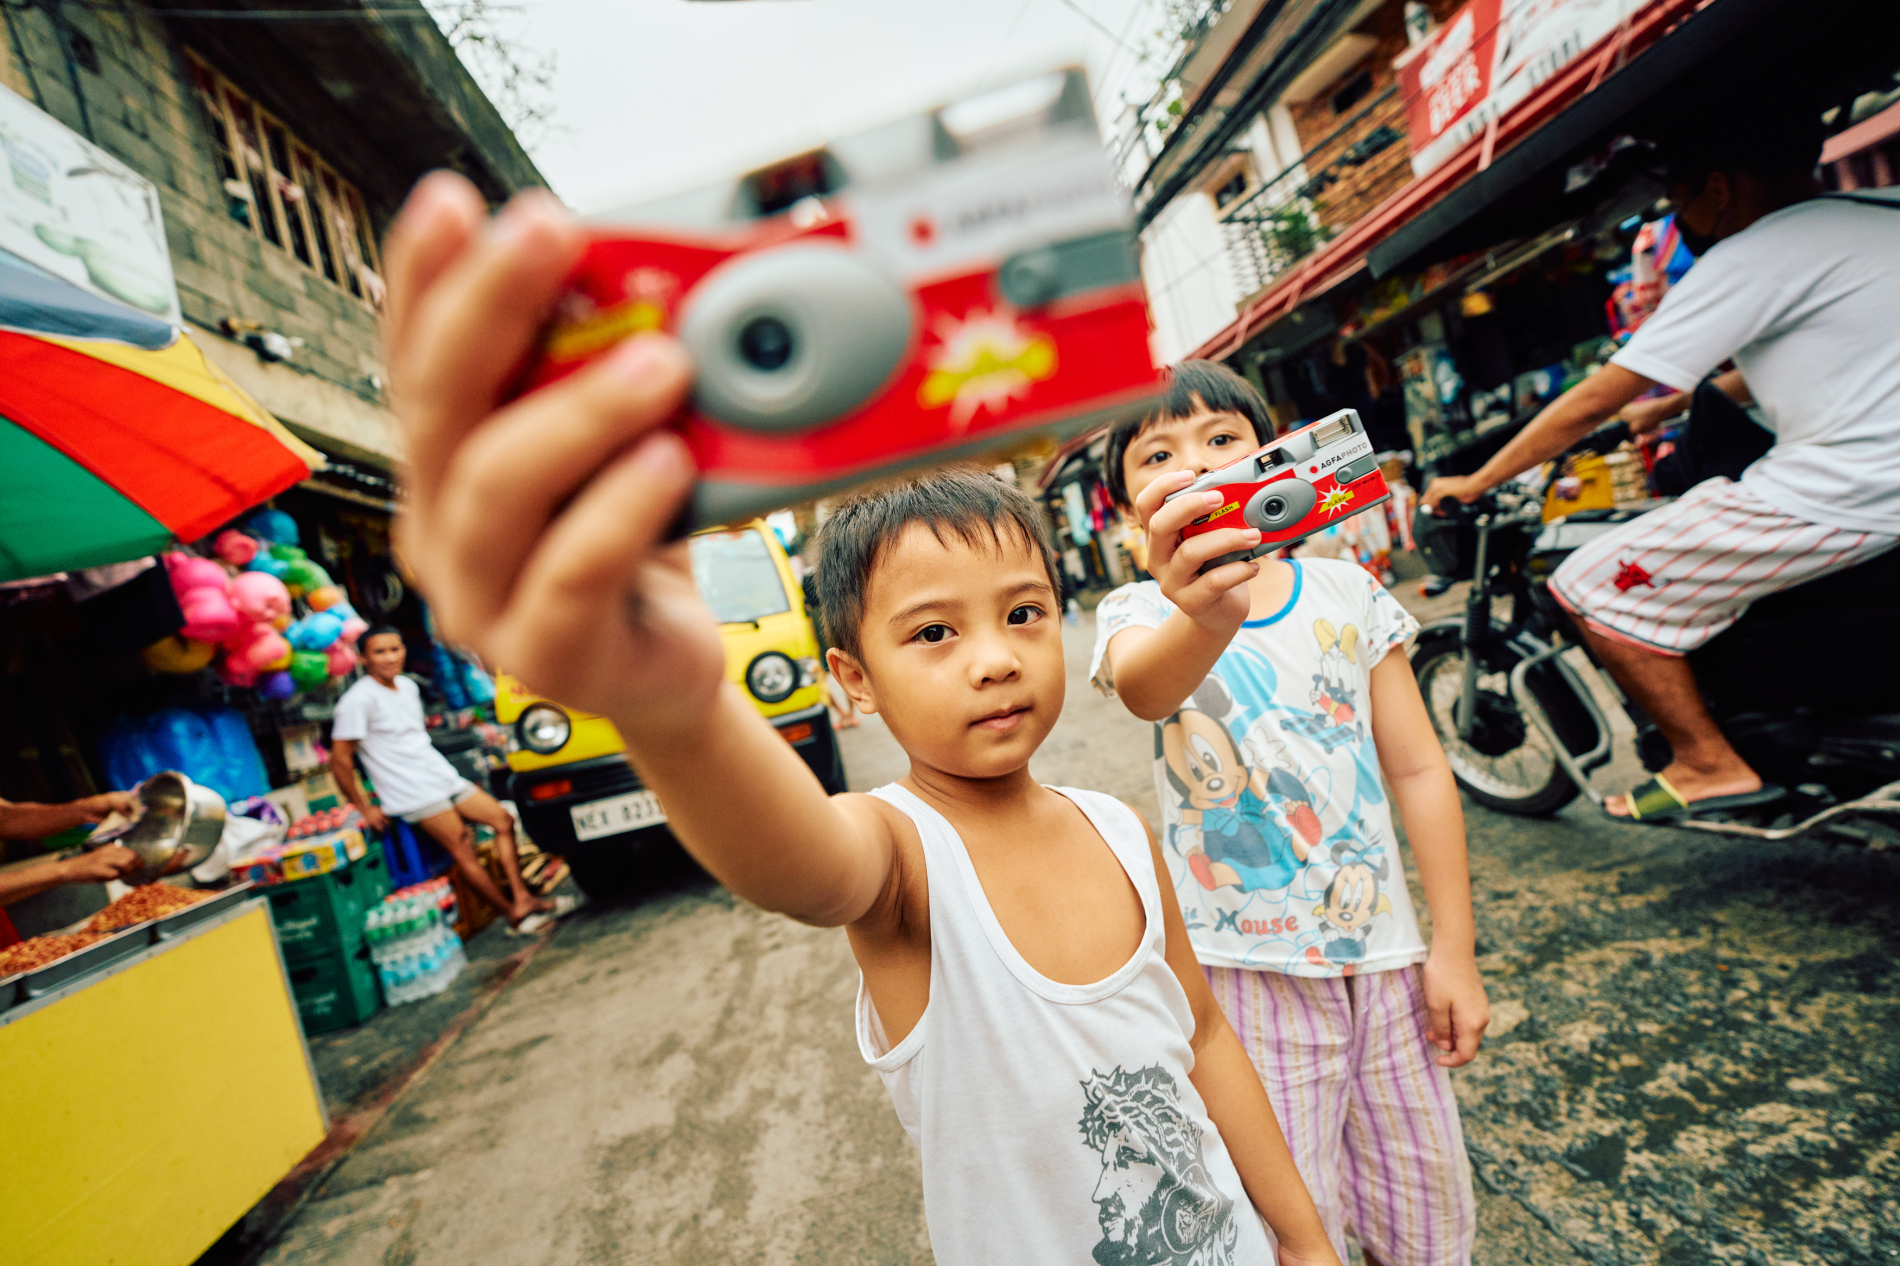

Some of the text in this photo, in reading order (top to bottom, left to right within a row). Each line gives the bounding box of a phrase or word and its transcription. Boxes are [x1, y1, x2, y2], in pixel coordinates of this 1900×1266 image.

[1321, 441, 1369, 470] AGFAPHOTO
[1214, 504, 1234, 517] FLASH
[1327, 495, 1347, 507] FLASH
[1214, 907, 1299, 936] Mouse
